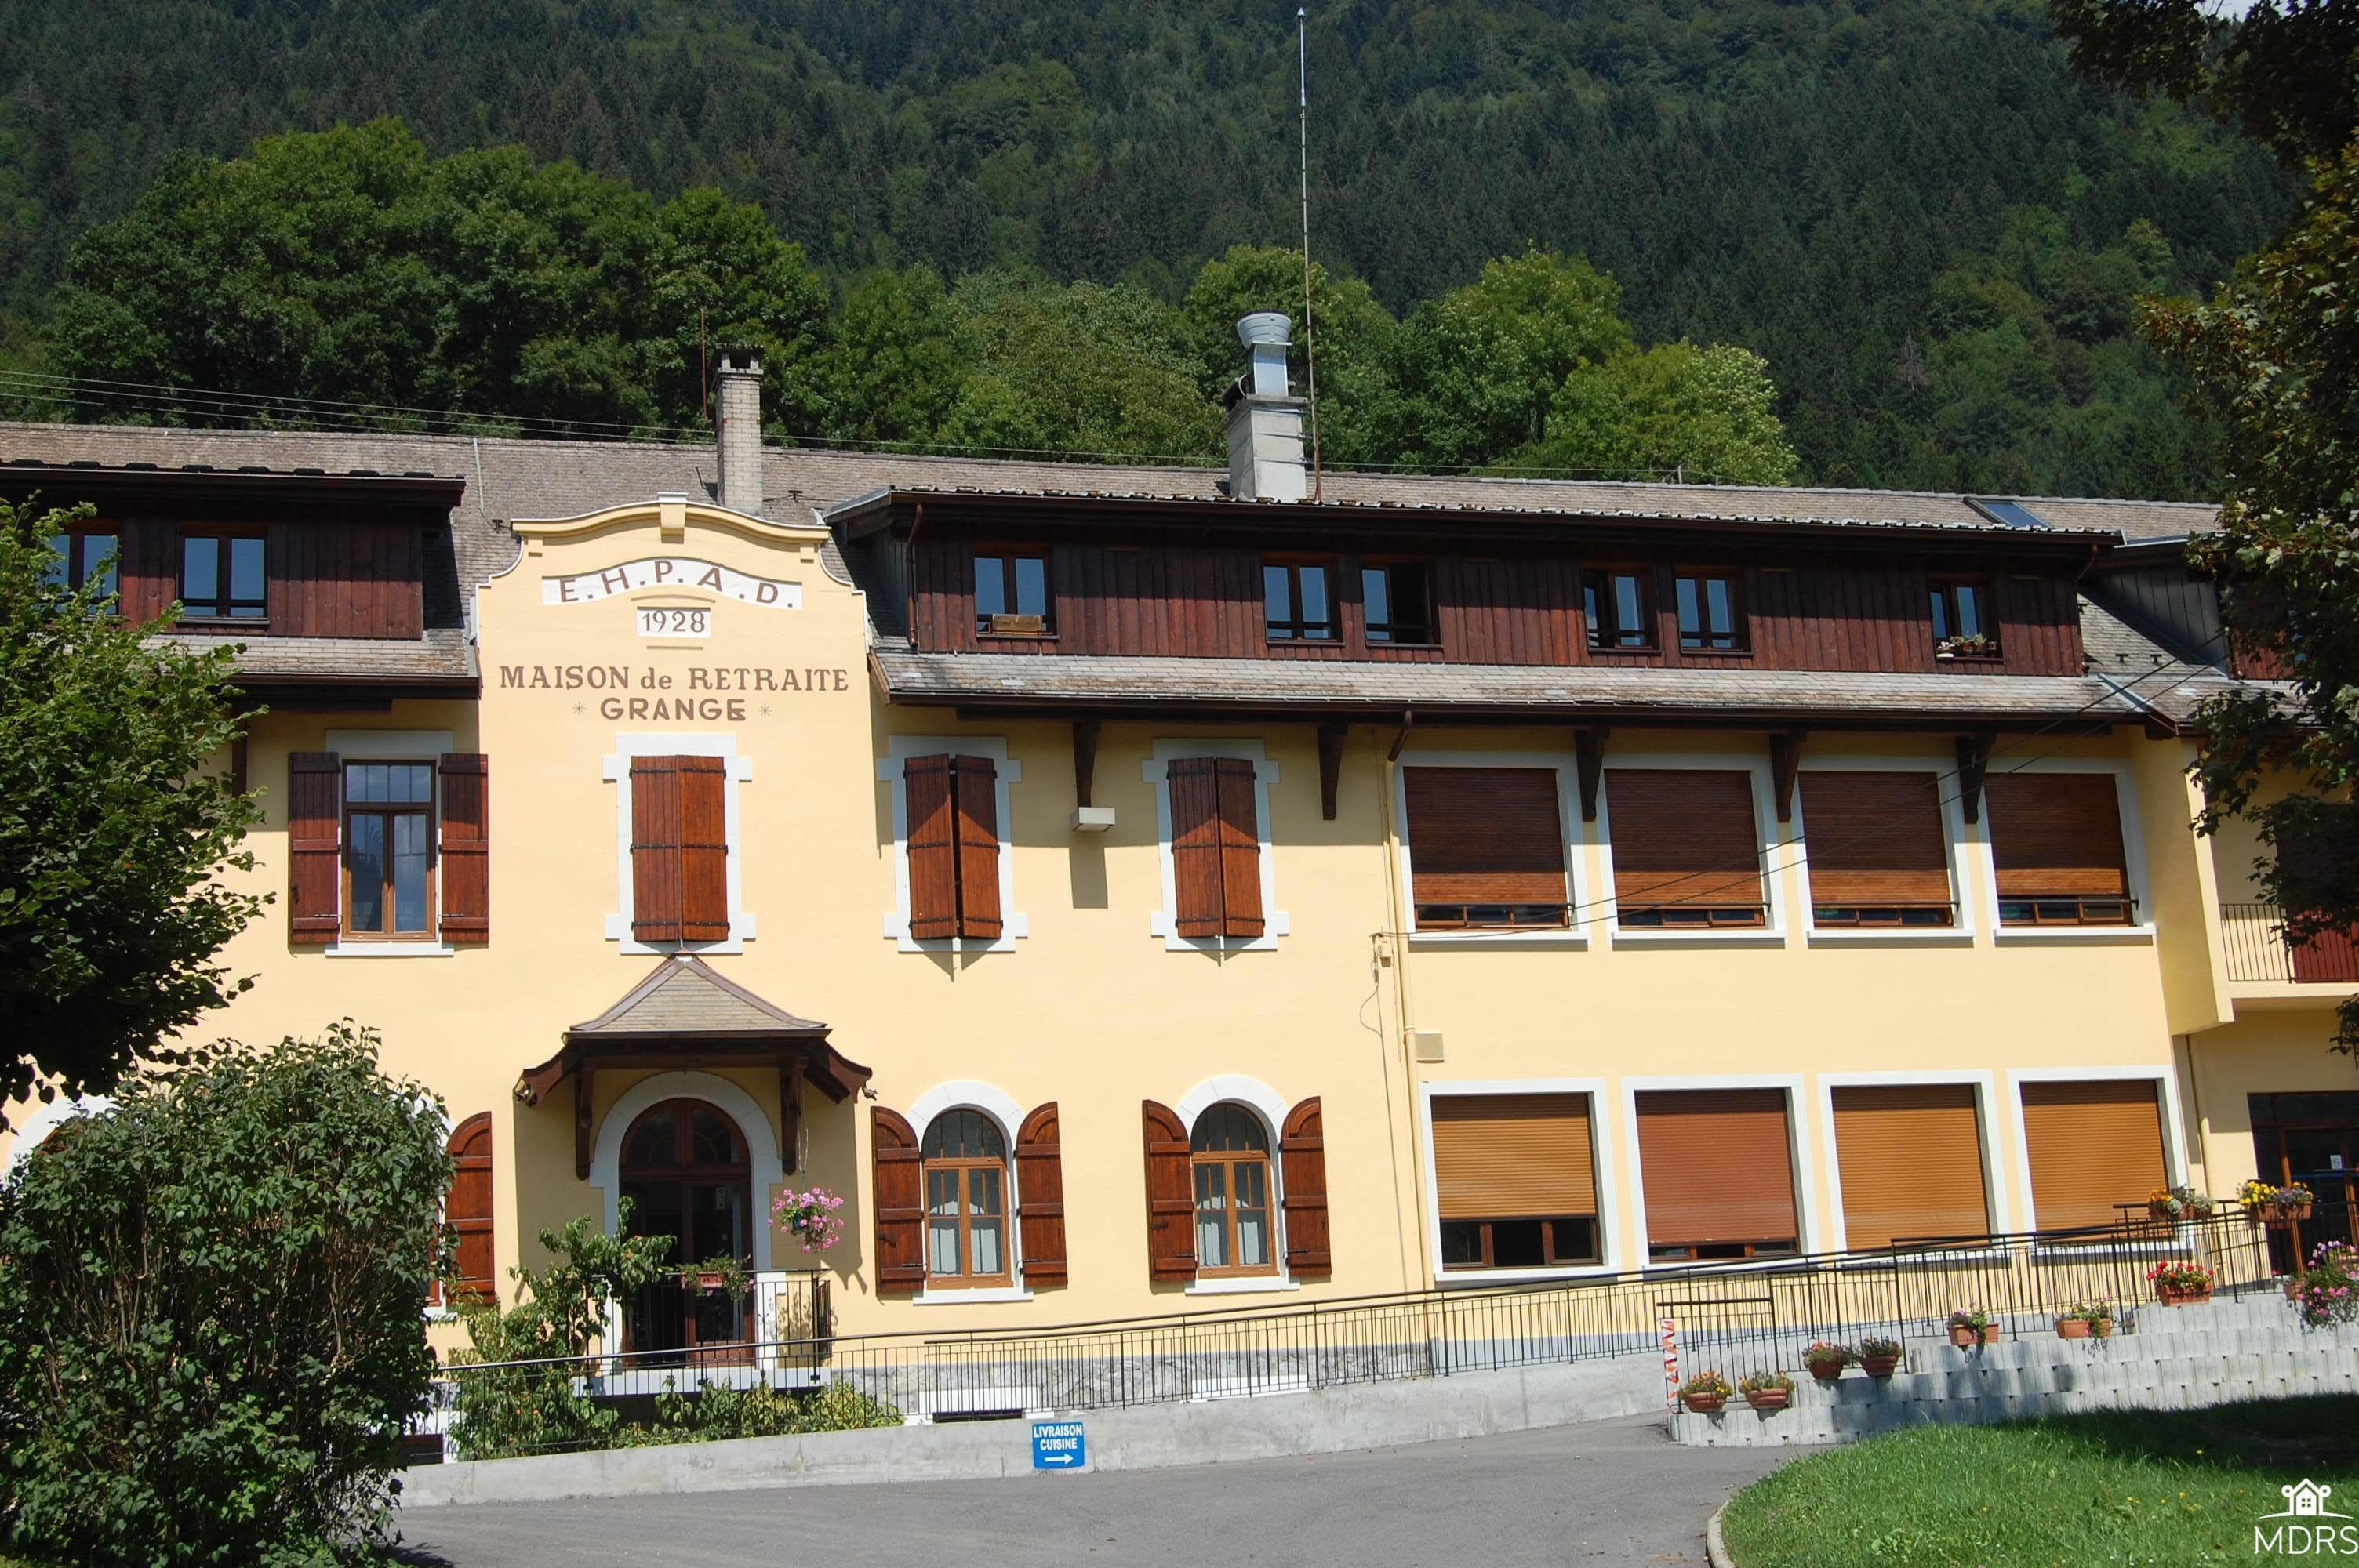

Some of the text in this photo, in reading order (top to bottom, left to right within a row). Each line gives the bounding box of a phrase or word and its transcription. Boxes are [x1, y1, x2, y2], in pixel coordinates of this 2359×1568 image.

[559, 560, 794, 608] E.H.P.A.D.
[642, 611, 706, 633] 1928
[500, 664, 849, 691] MAISON de RETRAITE
[600, 697, 747, 721] GRANGE
[1034, 1425, 1082, 1438] LIVRAISON
[1040, 1438, 1078, 1450] CUISINE
